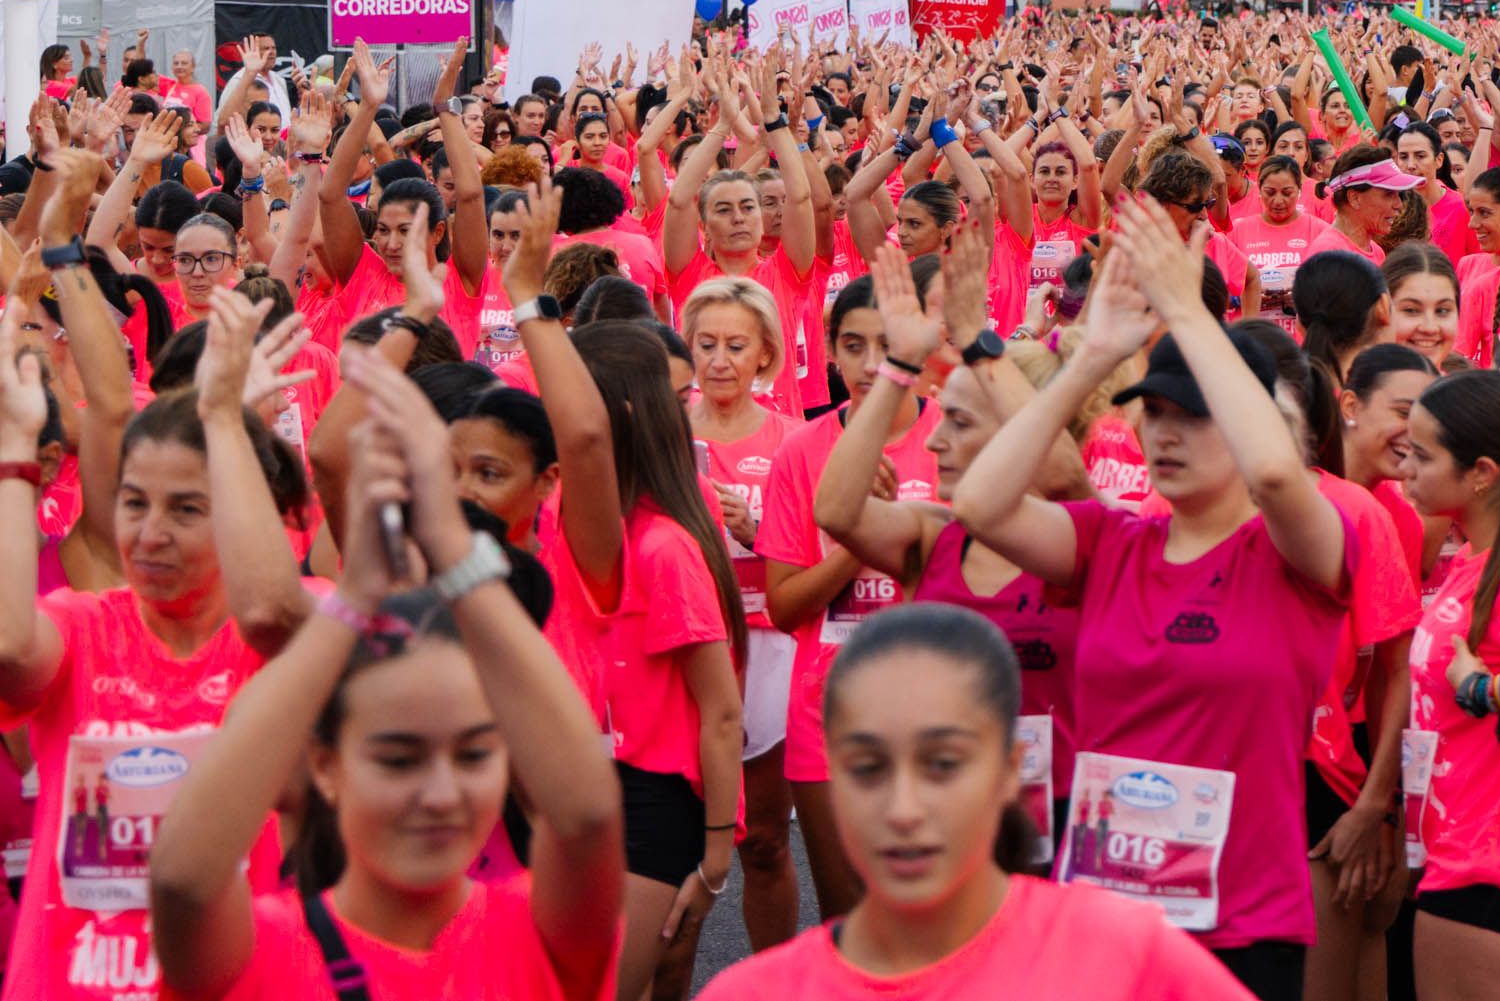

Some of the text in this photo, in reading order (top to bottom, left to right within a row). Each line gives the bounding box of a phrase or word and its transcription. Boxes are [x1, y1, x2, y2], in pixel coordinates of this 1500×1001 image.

[1249, 252, 1302, 266] CARRERA
[1033, 268, 1057, 278] 016
[854, 579, 896, 600] 016
[113, 762, 183, 778] ASTURIANA
[111, 816, 154, 845] 01
[1108, 833, 1166, 866] 016
[68, 934, 159, 988] MUJ
